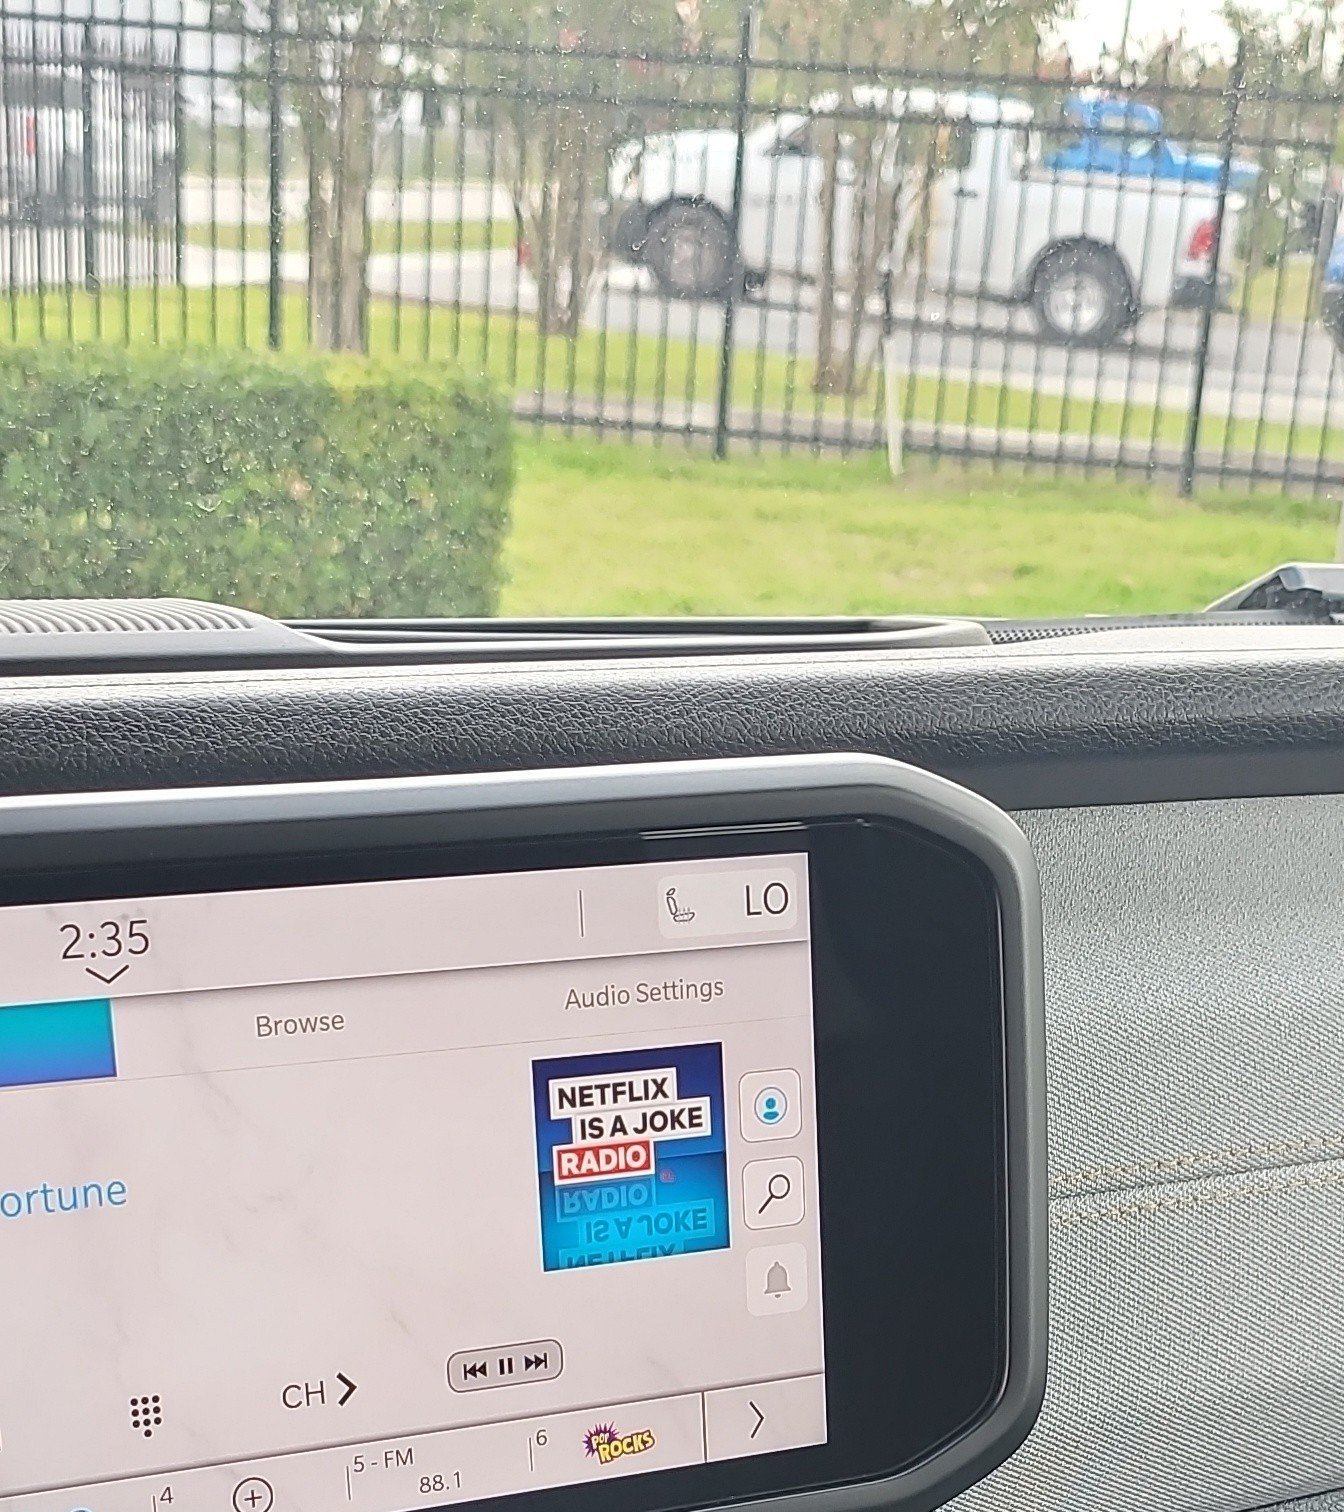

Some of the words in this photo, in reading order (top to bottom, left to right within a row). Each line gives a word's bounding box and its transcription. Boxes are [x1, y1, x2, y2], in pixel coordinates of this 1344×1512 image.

[745, 882, 790, 917] LO
[58, 919, 151, 962] 2:35
[565, 984, 631, 1011] Audio
[635, 977, 725, 1005] Settings
[255, 1011, 346, 1038] Browse
[557, 1076, 670, 1111] NETFLIX
[580, 1117, 605, 1140] IS
[609, 1114, 630, 1137] A
[633, 1105, 704, 1133] JOKE
[560, 1145, 648, 1177] RADIO
[281, 1381, 327, 1409] CH
[536, 1429, 548, 1446] 6
[599, 1430, 656, 1465] ROCKS
[353, 1455, 365, 1473] 5
[384, 1447, 414, 1469] FM
[160, 1487, 174, 1506] 4
[419, 1471, 463, 1494] 88.1
